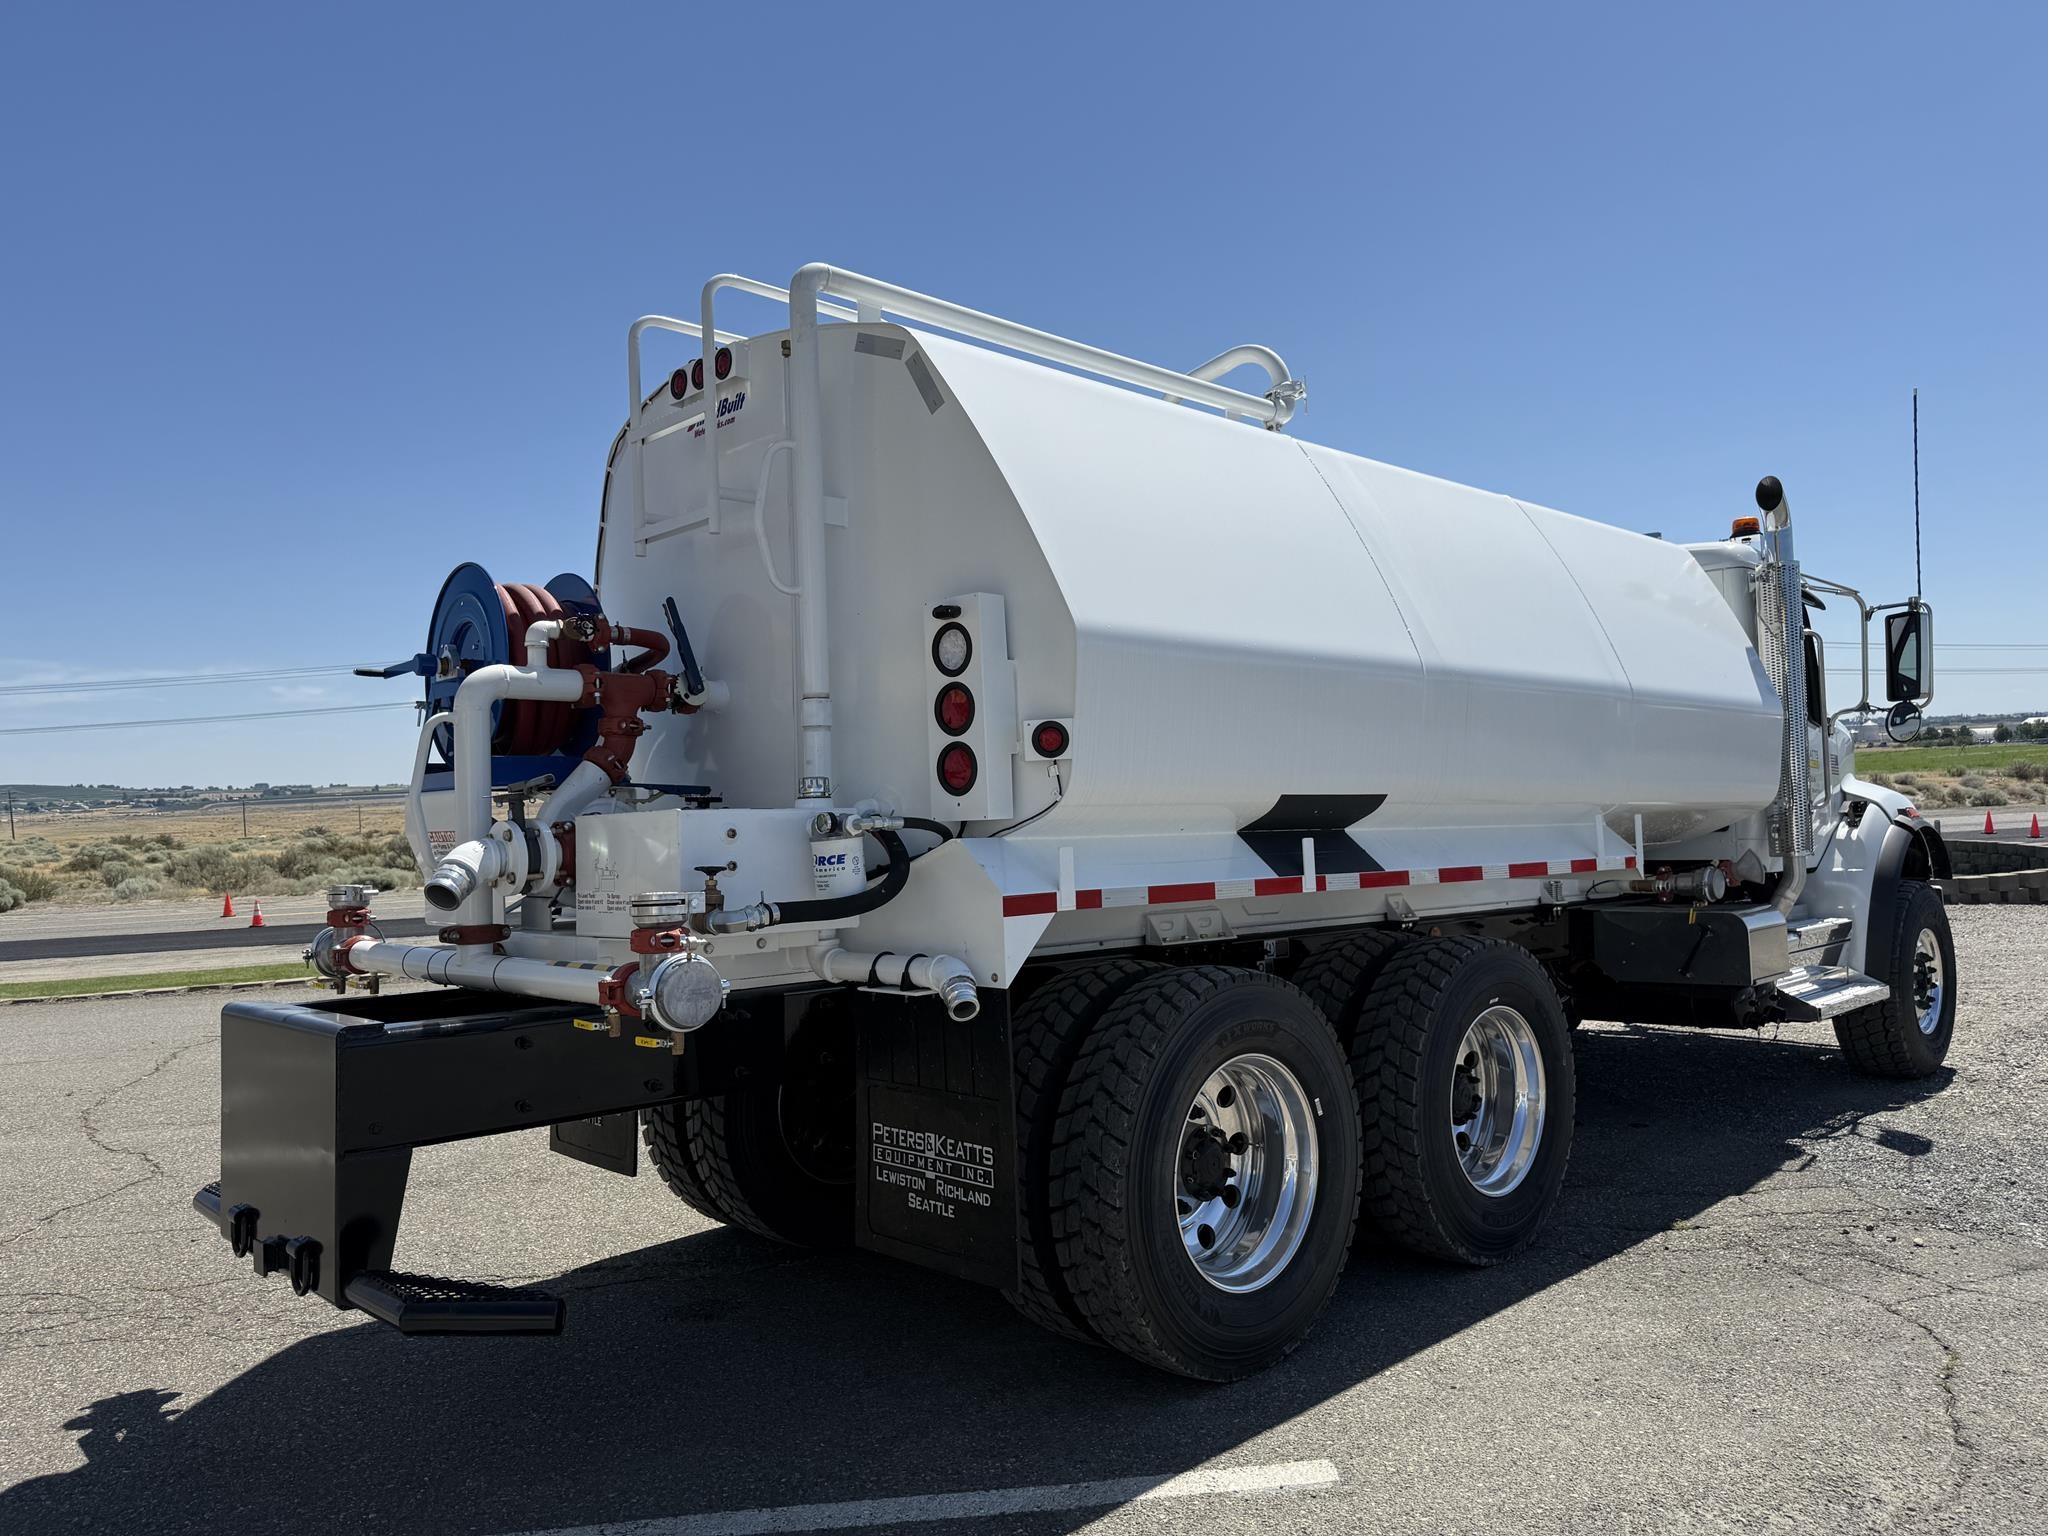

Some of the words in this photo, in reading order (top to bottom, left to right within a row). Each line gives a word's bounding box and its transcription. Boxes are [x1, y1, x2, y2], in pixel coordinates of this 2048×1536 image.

[872, 1122, 925, 1150] PETERS
[936, 1135, 994, 1166] KEATTS
[876, 1148, 953, 1175] EQUIPMENT
[961, 1167, 990, 1184] INC.
[876, 1165, 926, 1191] LEWISTON
[936, 1180, 991, 1207] RICHLAND
[908, 1193, 956, 1218] SEATTLE
